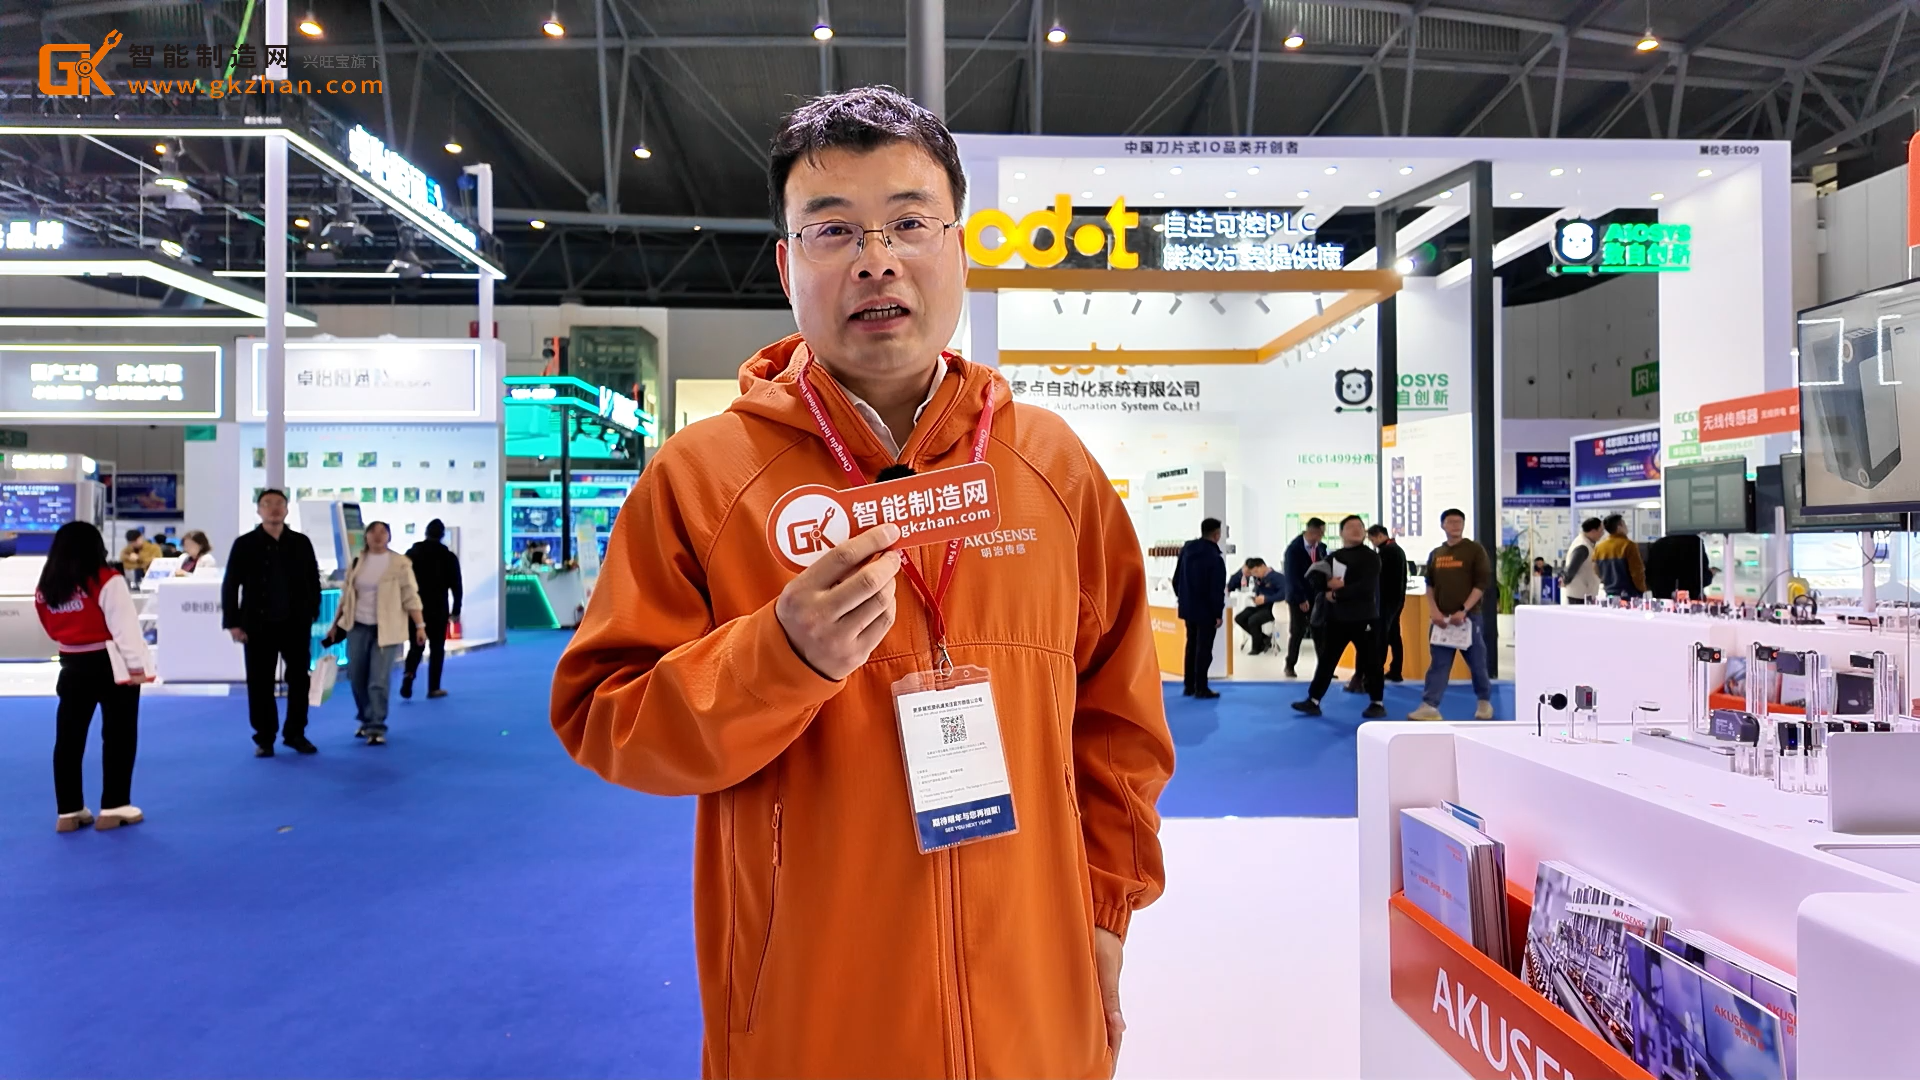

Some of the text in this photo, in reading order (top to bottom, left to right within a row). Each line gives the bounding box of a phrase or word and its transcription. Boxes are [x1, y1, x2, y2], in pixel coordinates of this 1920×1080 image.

[1124, 140, 1299, 154] 中国刀片式IO品类开创者
[1164, 210, 1317, 239] 自主可控PLC
[1162, 242, 1345, 272] 解决方案提供商
[1007, 380, 1201, 399] 零点自动化系统有限公司
[1121, 402, 1159, 413] System
[1702, 407, 1759, 432] 无线传感器
[804, 391, 853, 472] Chengdu International
[1298, 453, 1378, 465] IEC61499分布
[852, 478, 988, 529] 智能制造网
[963, 528, 1038, 549] AKUSENSE
[980, 544, 1026, 559] 明治传感
[1432, 966, 1575, 1080] AKUSE
